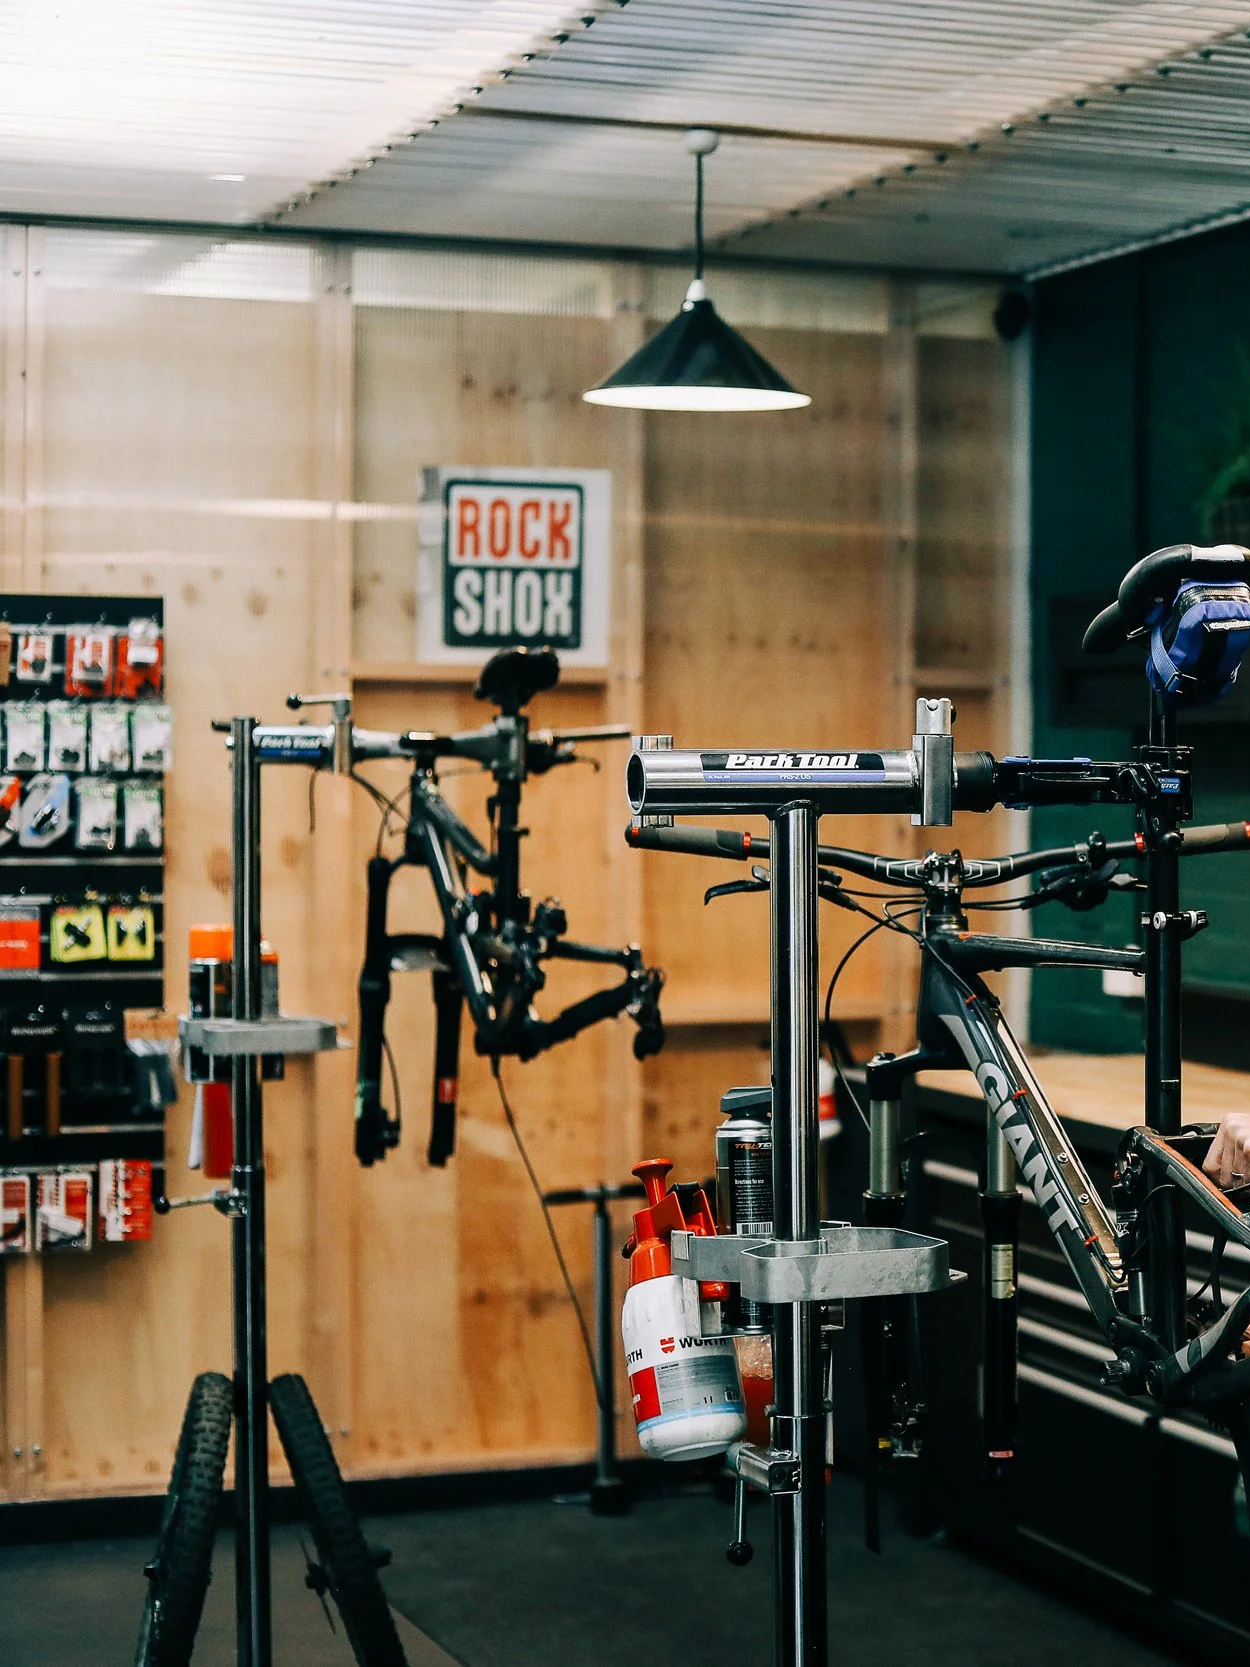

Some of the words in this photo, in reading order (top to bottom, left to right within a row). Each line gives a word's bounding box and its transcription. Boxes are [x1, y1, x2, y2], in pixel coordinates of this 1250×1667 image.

[458, 498, 571, 559] ROCK
[454, 569, 573, 637] SHOX
[726, 753, 794, 769] Park
[794, 753, 858, 769] Tool
[977, 1062, 1079, 1233] GIANT
[626, 1348, 643, 1366] RTH
